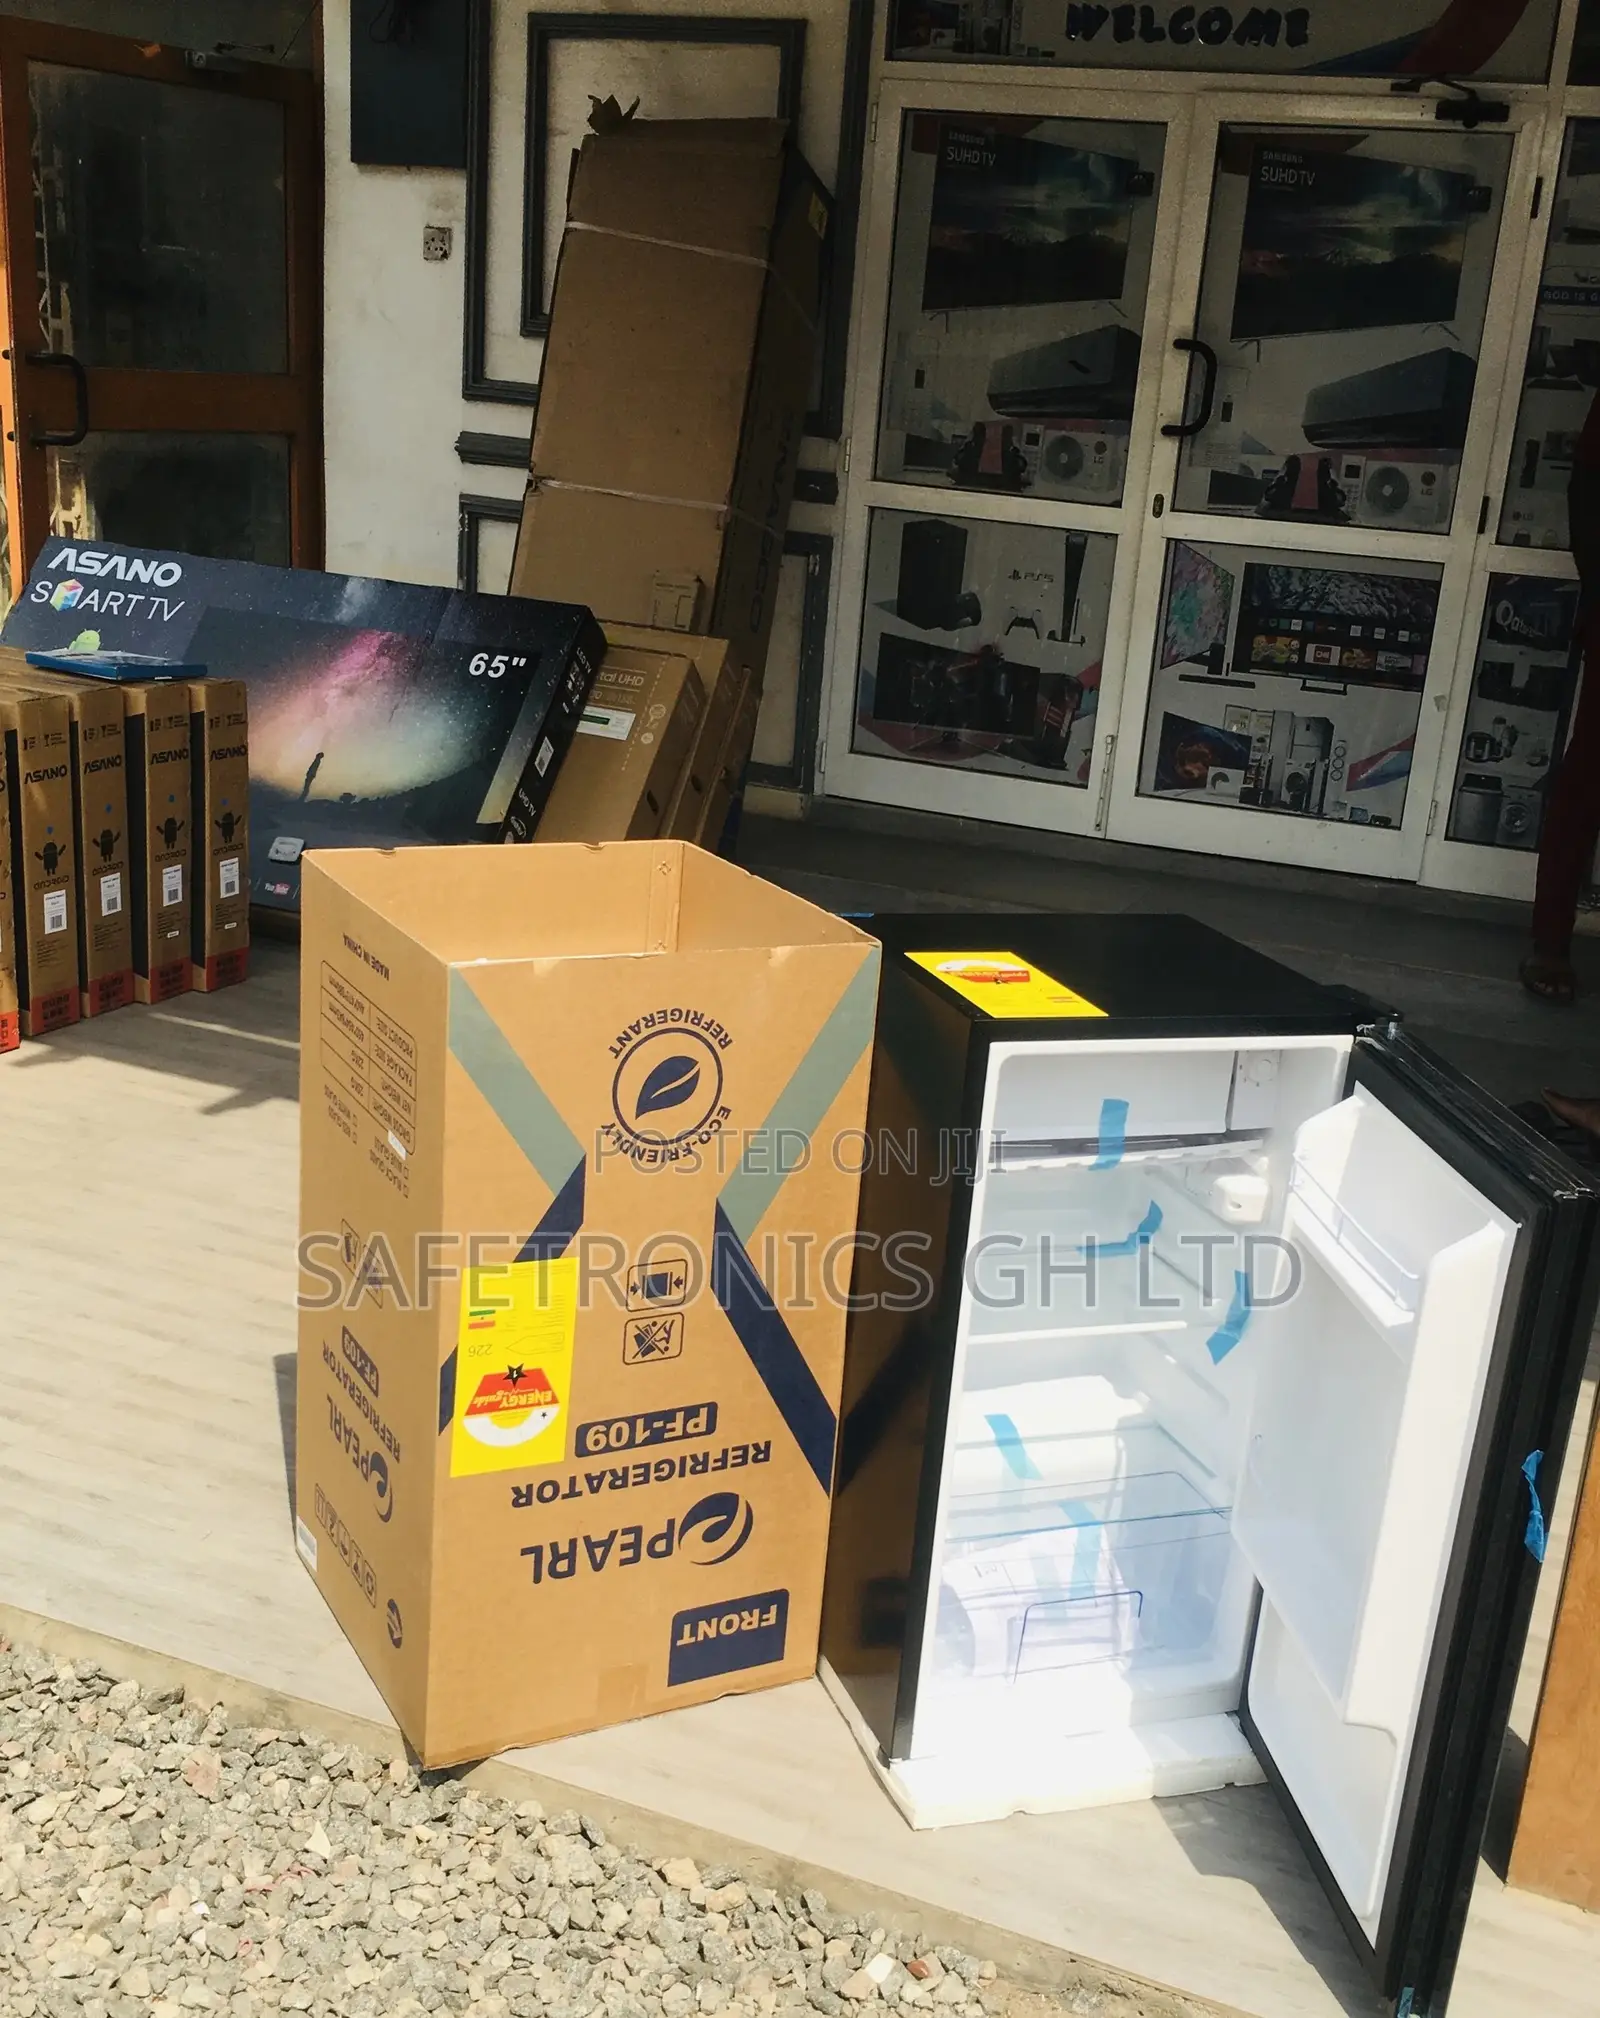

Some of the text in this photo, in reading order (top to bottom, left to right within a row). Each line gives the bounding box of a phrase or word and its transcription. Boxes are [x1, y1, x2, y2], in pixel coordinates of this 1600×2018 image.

[1066, 3, 1311, 48] WELCOME
[1261, 166, 1316, 186] SUHD TV
[1420, 488, 1433, 497] LG
[47, 547, 182, 588] ASANO
[1024, 572, 1054, 583] PS5
[30, 578, 186, 622] SART TV
[468, 652, 527, 678] 65"
[618, 672, 645, 686] UHD
[83, 754, 122, 775] ASANO
[150, 748, 190, 765] ASANO
[210, 744, 248, 762] ASANO
[24, 764, 68, 785] ASANO
[342, 931, 363, 959] CHINA
[371, 955, 390, 982] MADE
[608, 1008, 733, 1060] REFRIGERANT
[600, 1105, 732, 1163] ECO-FRIENDLY
[343, 1332, 378, 1392] PF-109
[468, 1343, 493, 1358] 226
[322, 1338, 401, 1464] REFRIGERATOR
[472, 1388, 553, 1409] ENERGY guide
[326, 1393, 372, 1483] PEARL
[585, 1406, 708, 1452] PF-109
[511, 1440, 772, 1509] REFRIGERATOR
[520, 1518, 676, 1585] PEARL
[675, 1603, 778, 1647] FRONT
